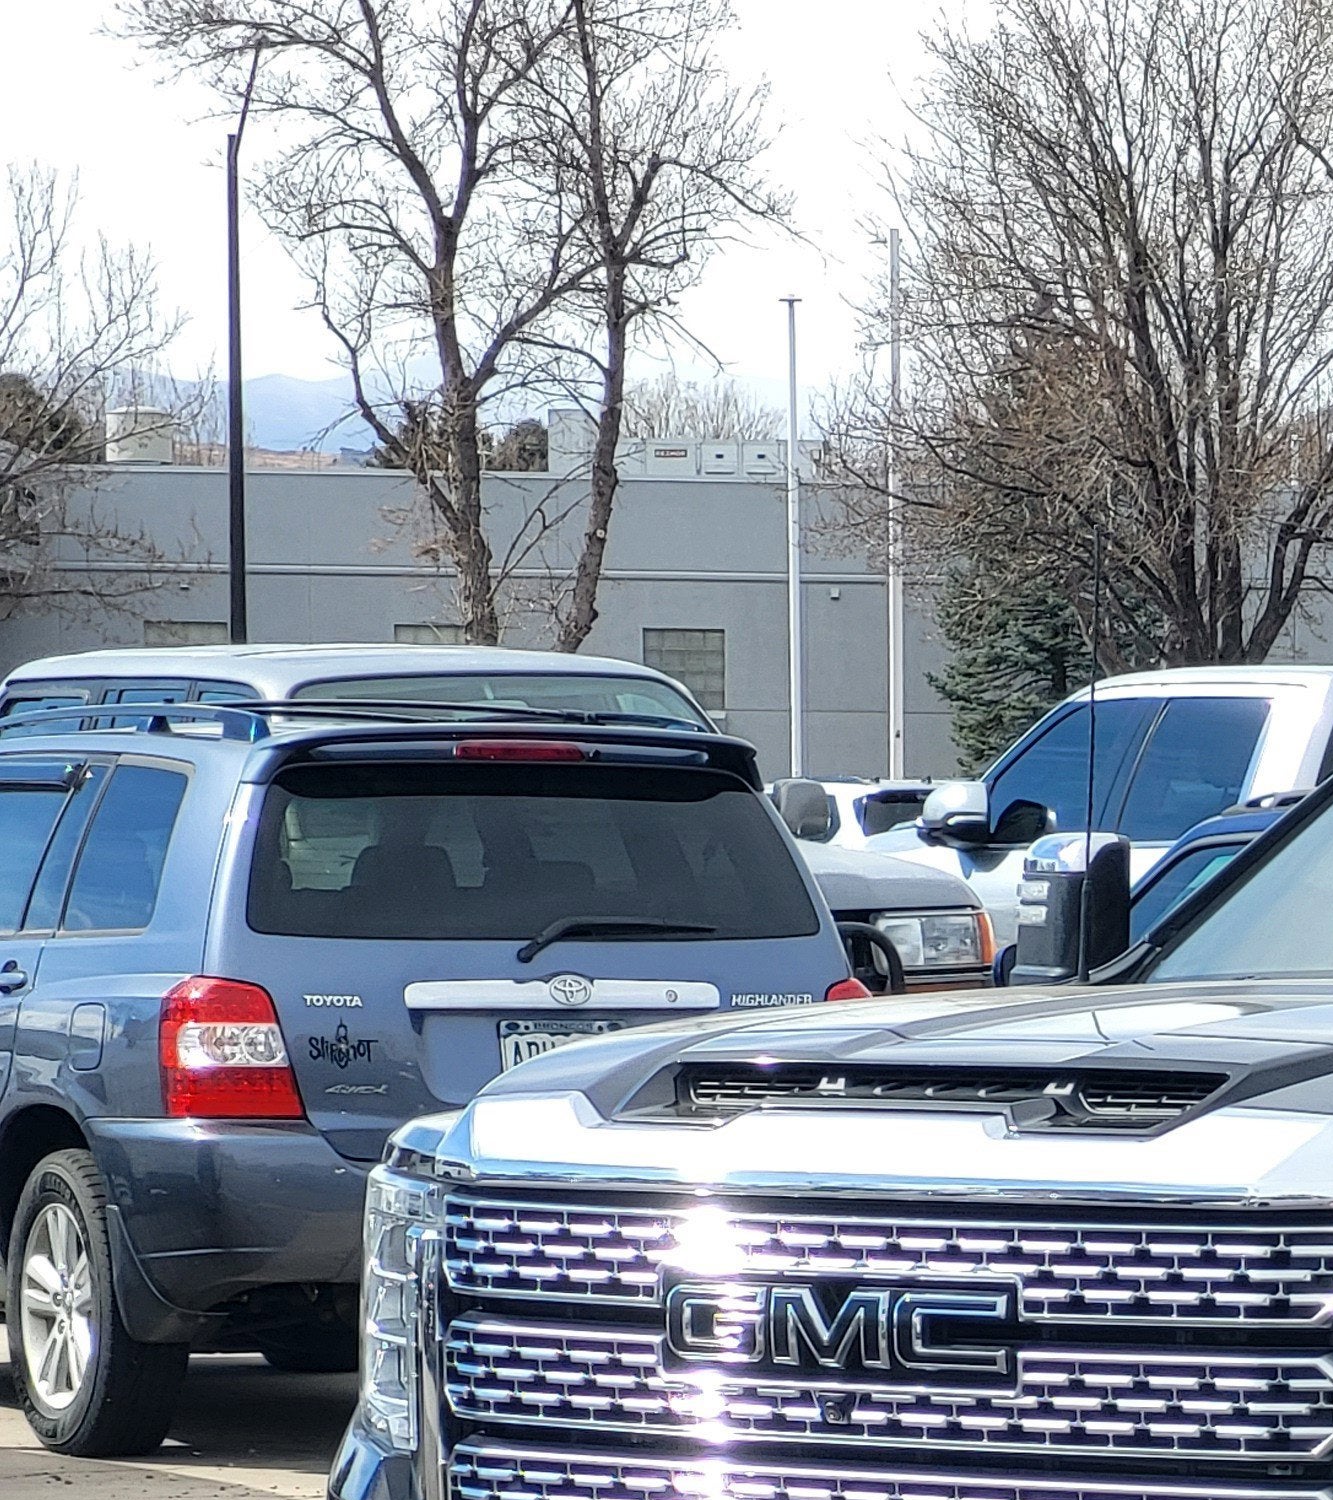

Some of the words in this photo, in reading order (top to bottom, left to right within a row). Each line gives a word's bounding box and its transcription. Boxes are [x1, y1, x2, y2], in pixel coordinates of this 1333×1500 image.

[303, 995, 363, 1008] TOYOTA
[731, 994, 812, 1007] HIGHLANDER
[666, 1284, 1009, 1374] GMC
